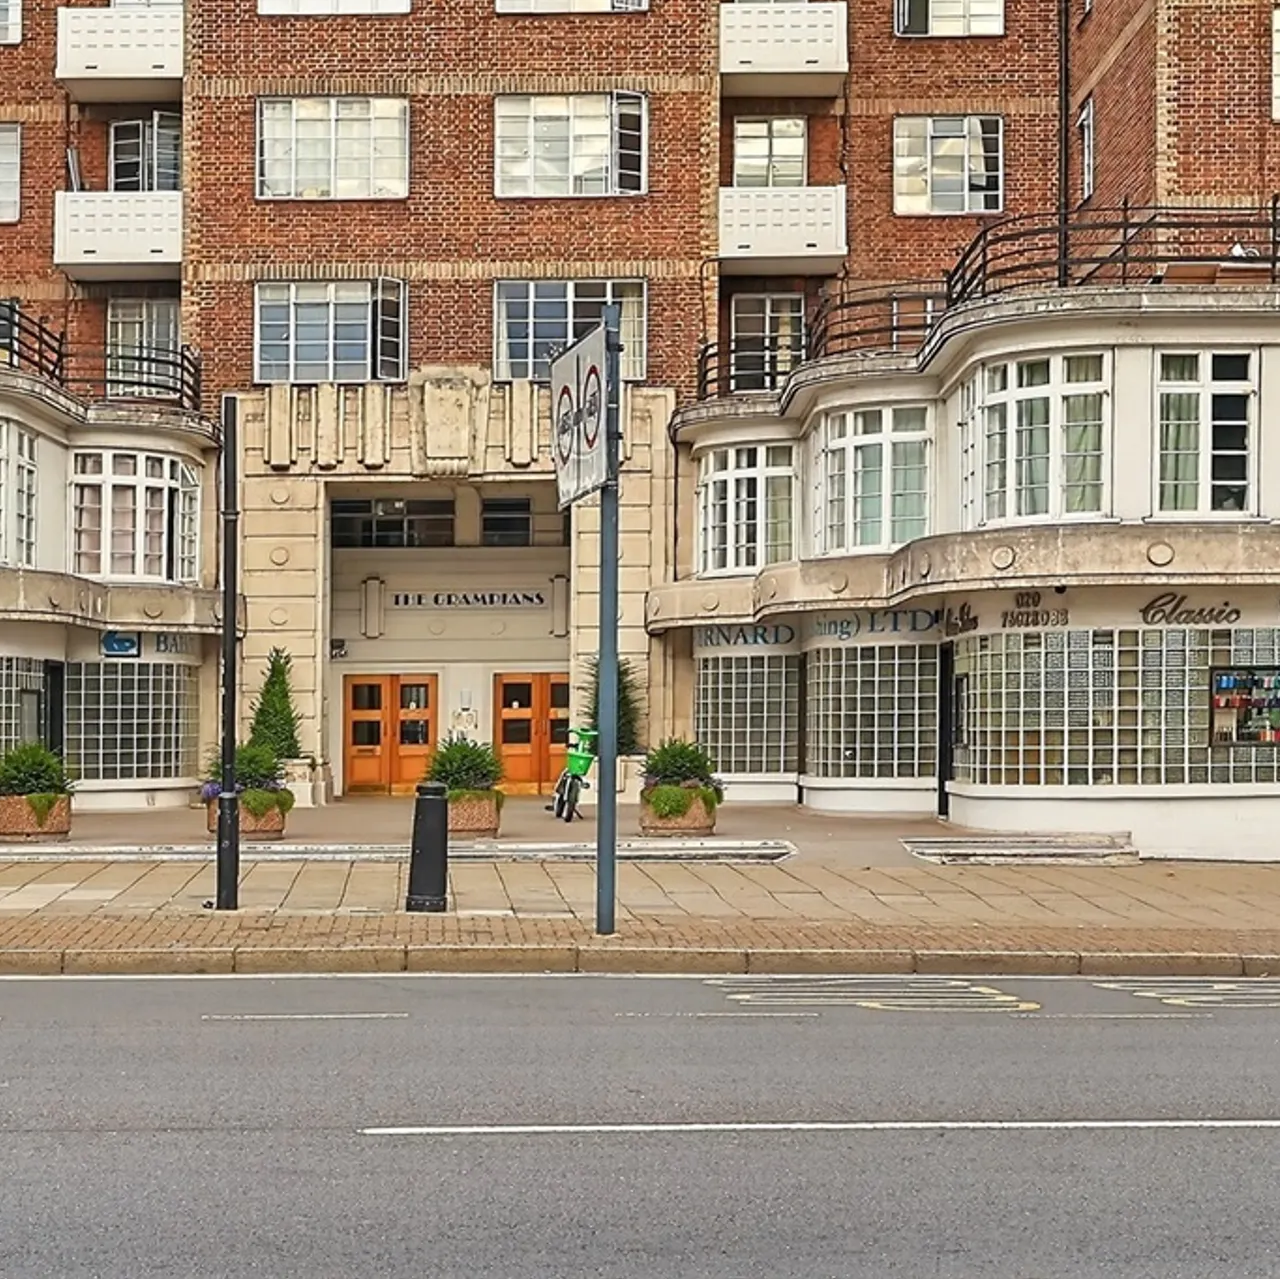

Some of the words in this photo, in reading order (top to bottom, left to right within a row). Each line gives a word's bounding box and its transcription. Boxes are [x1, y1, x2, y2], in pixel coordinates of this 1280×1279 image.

[393, 592, 426, 606] THE
[433, 591, 545, 606] GRAMPIANS
[1138, 591, 1242, 625] Classic
[868, 608, 934, 633] LTD
